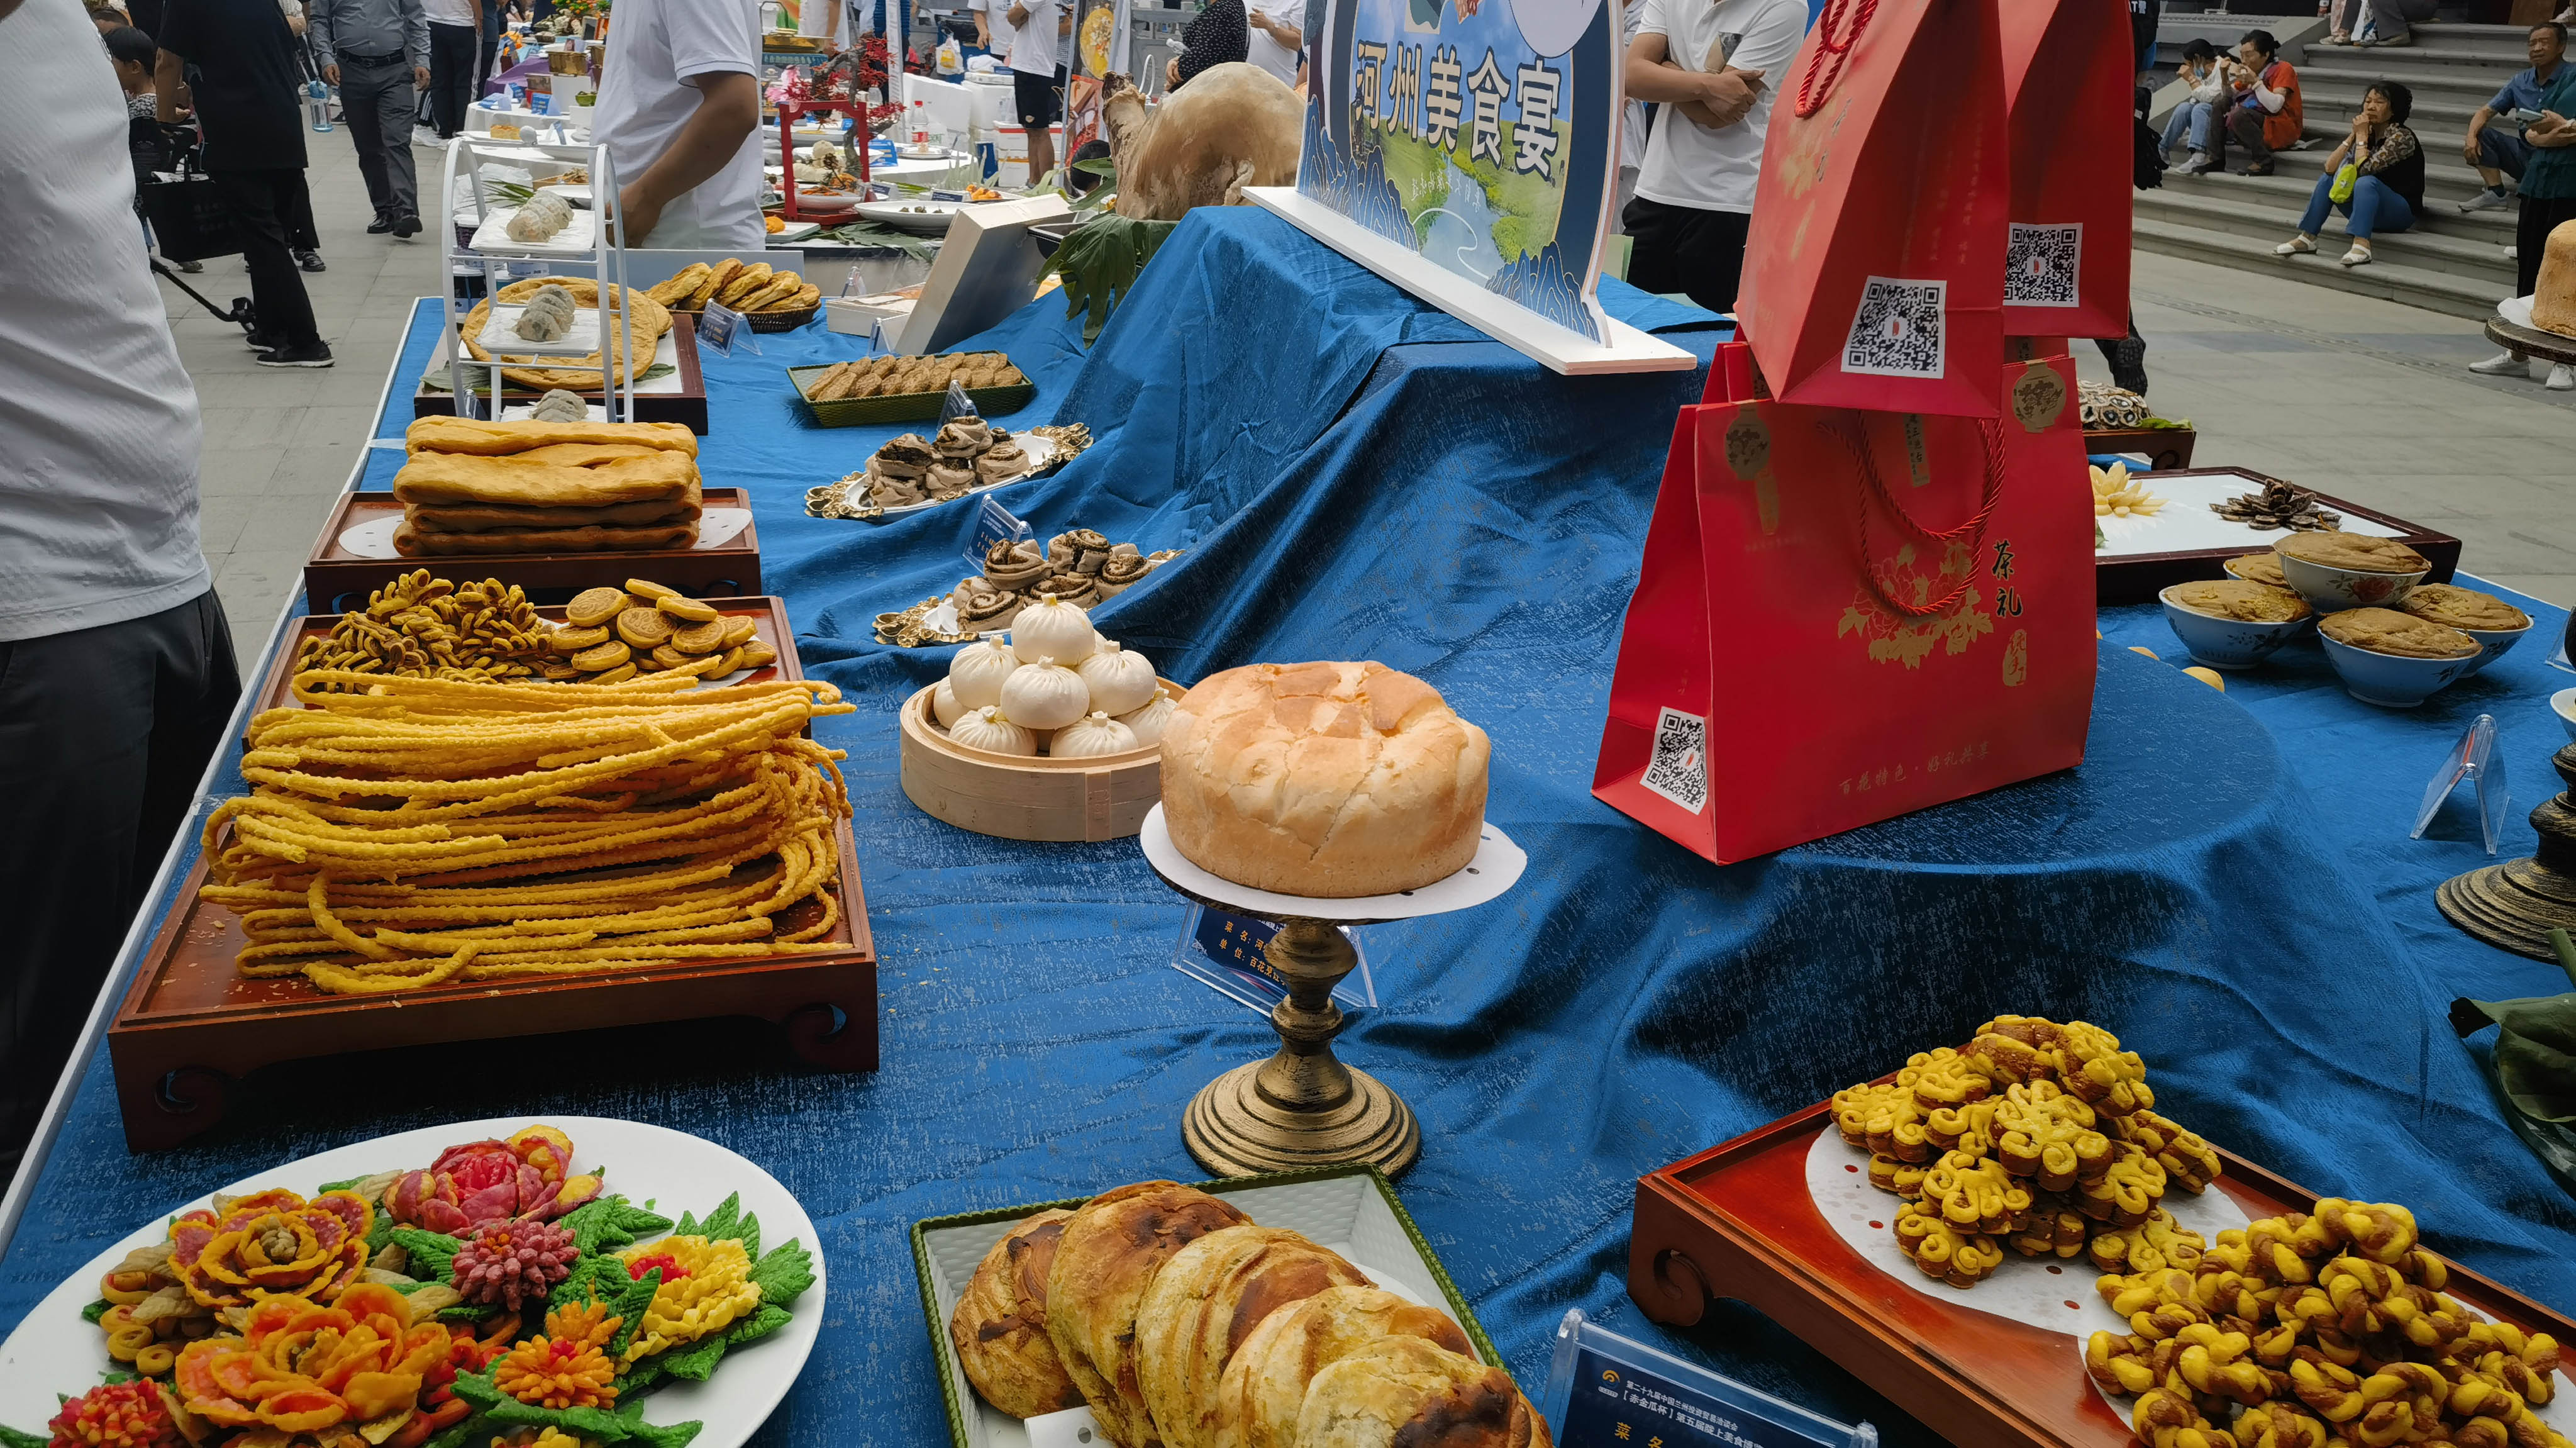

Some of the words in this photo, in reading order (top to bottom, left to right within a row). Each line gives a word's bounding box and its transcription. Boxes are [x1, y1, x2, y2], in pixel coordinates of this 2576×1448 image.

[1354, 42, 1562, 179] 河州美食宴
[1992, 539, 2023, 618] 茶礼
